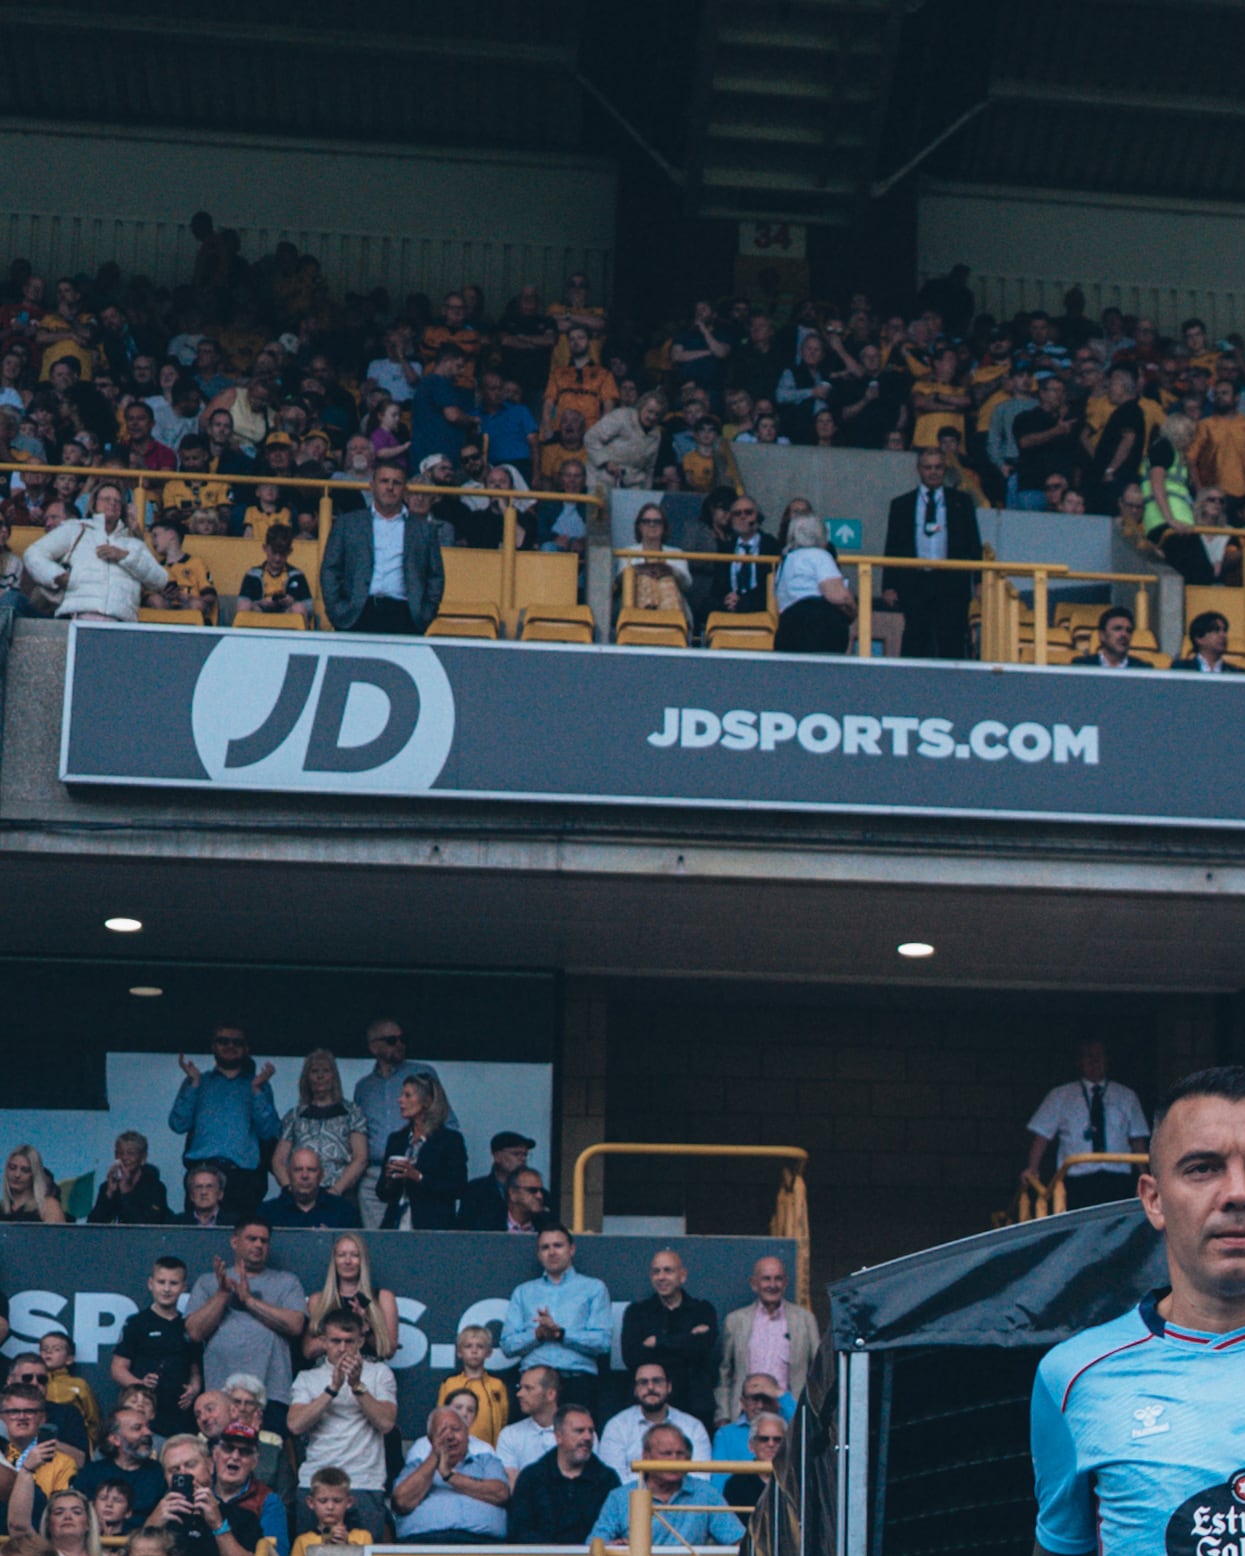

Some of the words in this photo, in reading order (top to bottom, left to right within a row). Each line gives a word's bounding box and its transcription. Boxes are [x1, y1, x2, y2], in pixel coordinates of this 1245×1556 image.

[753, 221, 793, 250] 34
[224, 653, 421, 773] JD
[647, 706, 1099, 764] JDSPORTS.COM
